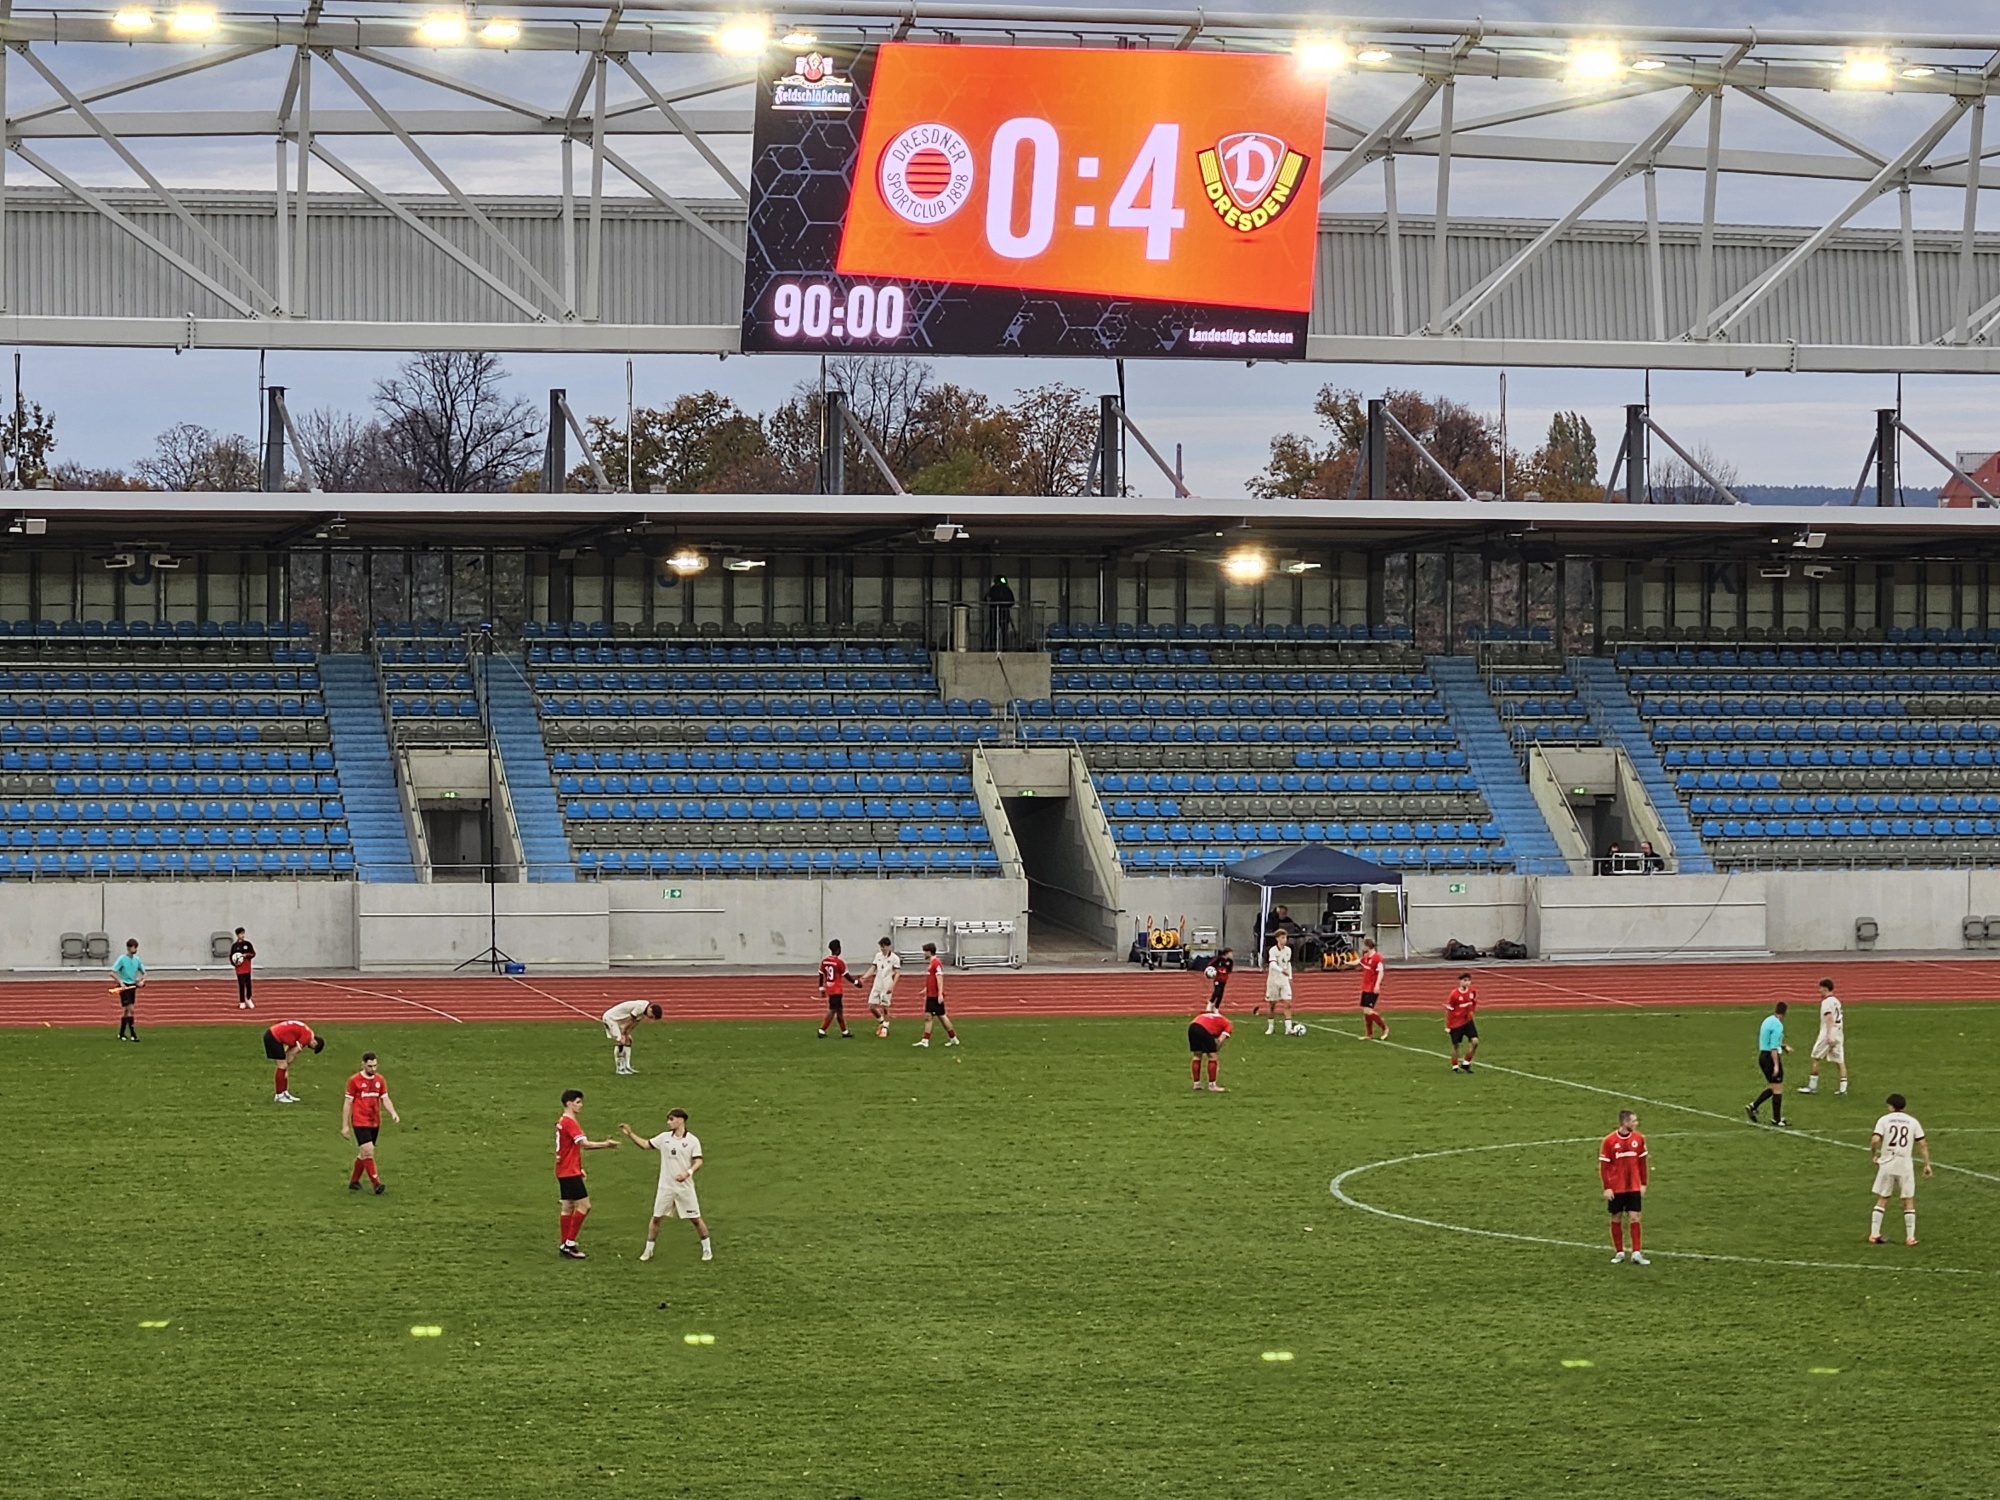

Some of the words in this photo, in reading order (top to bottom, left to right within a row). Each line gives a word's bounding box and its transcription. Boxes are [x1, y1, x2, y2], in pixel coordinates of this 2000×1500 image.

[892, 128, 967, 163] DRESDNER
[887, 172, 947, 218] SPORTCLUB
[946, 174, 969, 205] 1898
[1206, 181, 1290, 232] DRESDEN
[774, 284, 904, 338] 90:00
[1188, 327, 1247, 345] Landesliga
[1247, 329, 1294, 344] Sachsen
[1888, 1124, 1909, 1148] 28
